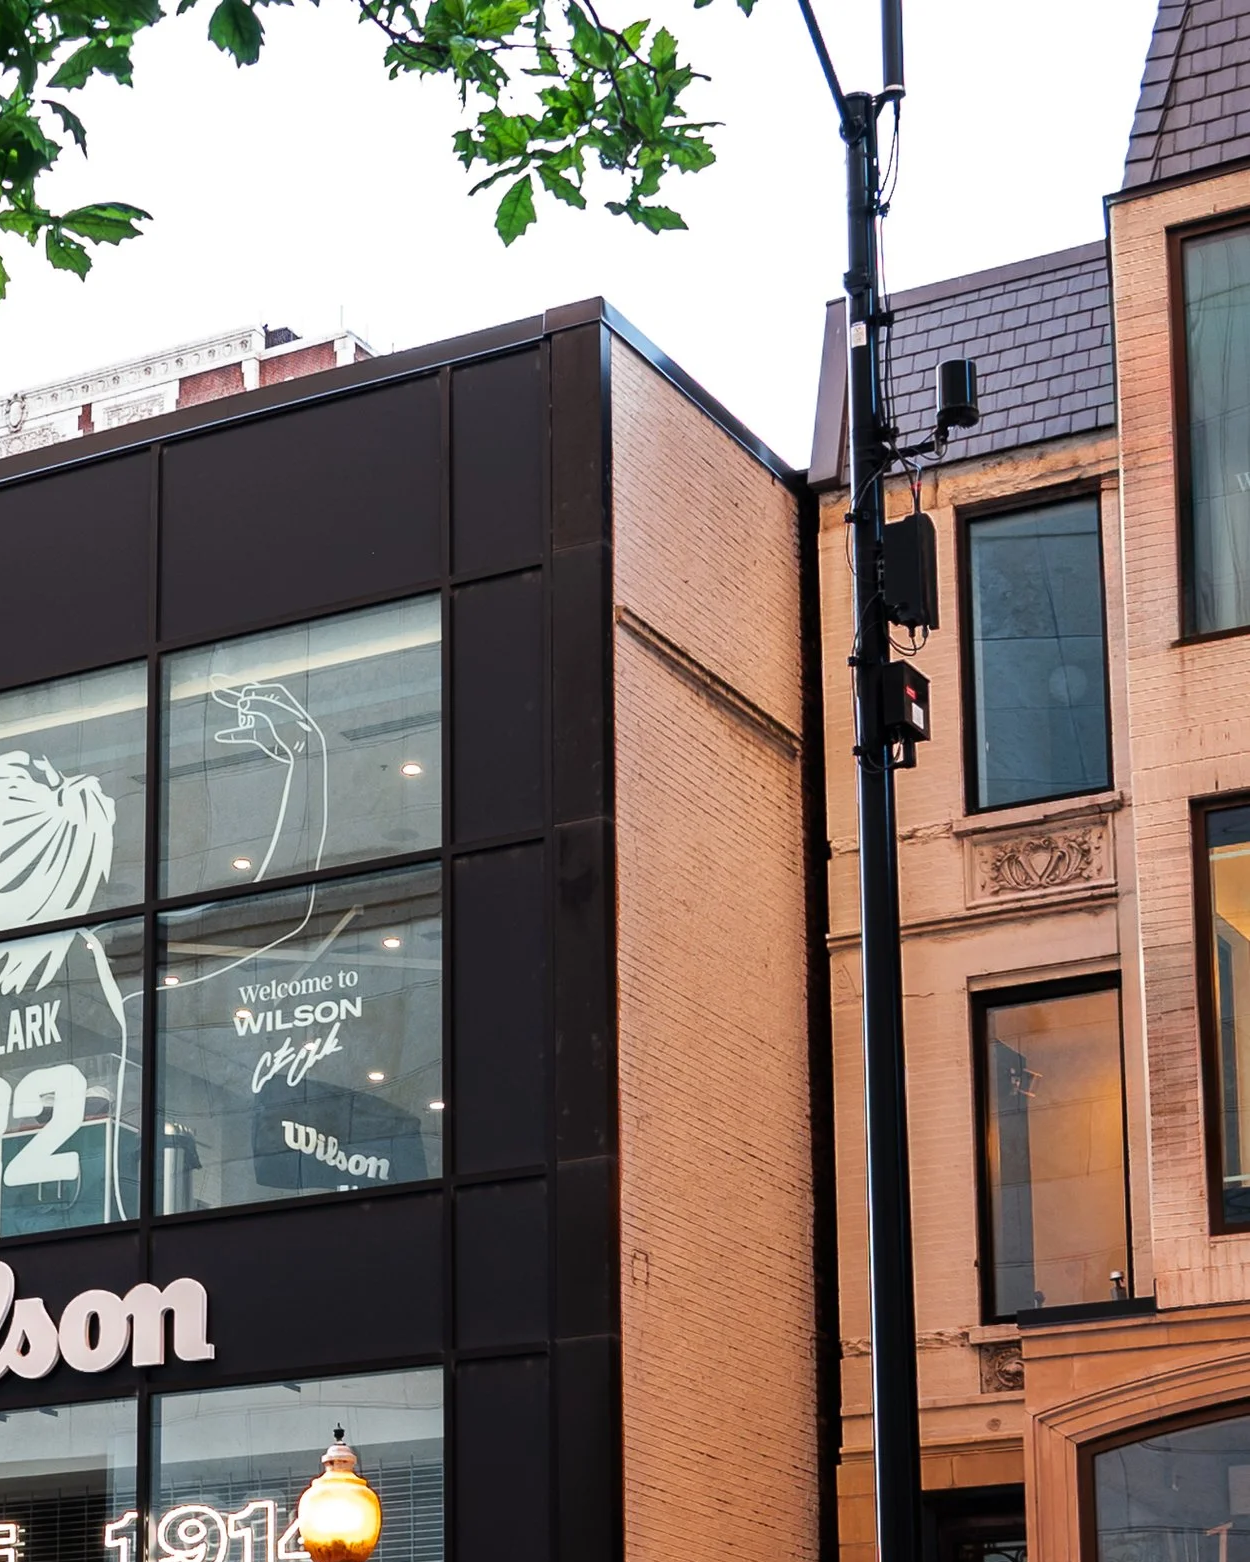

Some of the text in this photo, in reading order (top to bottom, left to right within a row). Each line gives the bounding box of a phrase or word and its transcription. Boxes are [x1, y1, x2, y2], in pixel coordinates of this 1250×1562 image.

[238, 969, 358, 1004] Welcome to
[233, 997, 363, 1036] WILSON
[281, 1120, 391, 1181] Wilson
